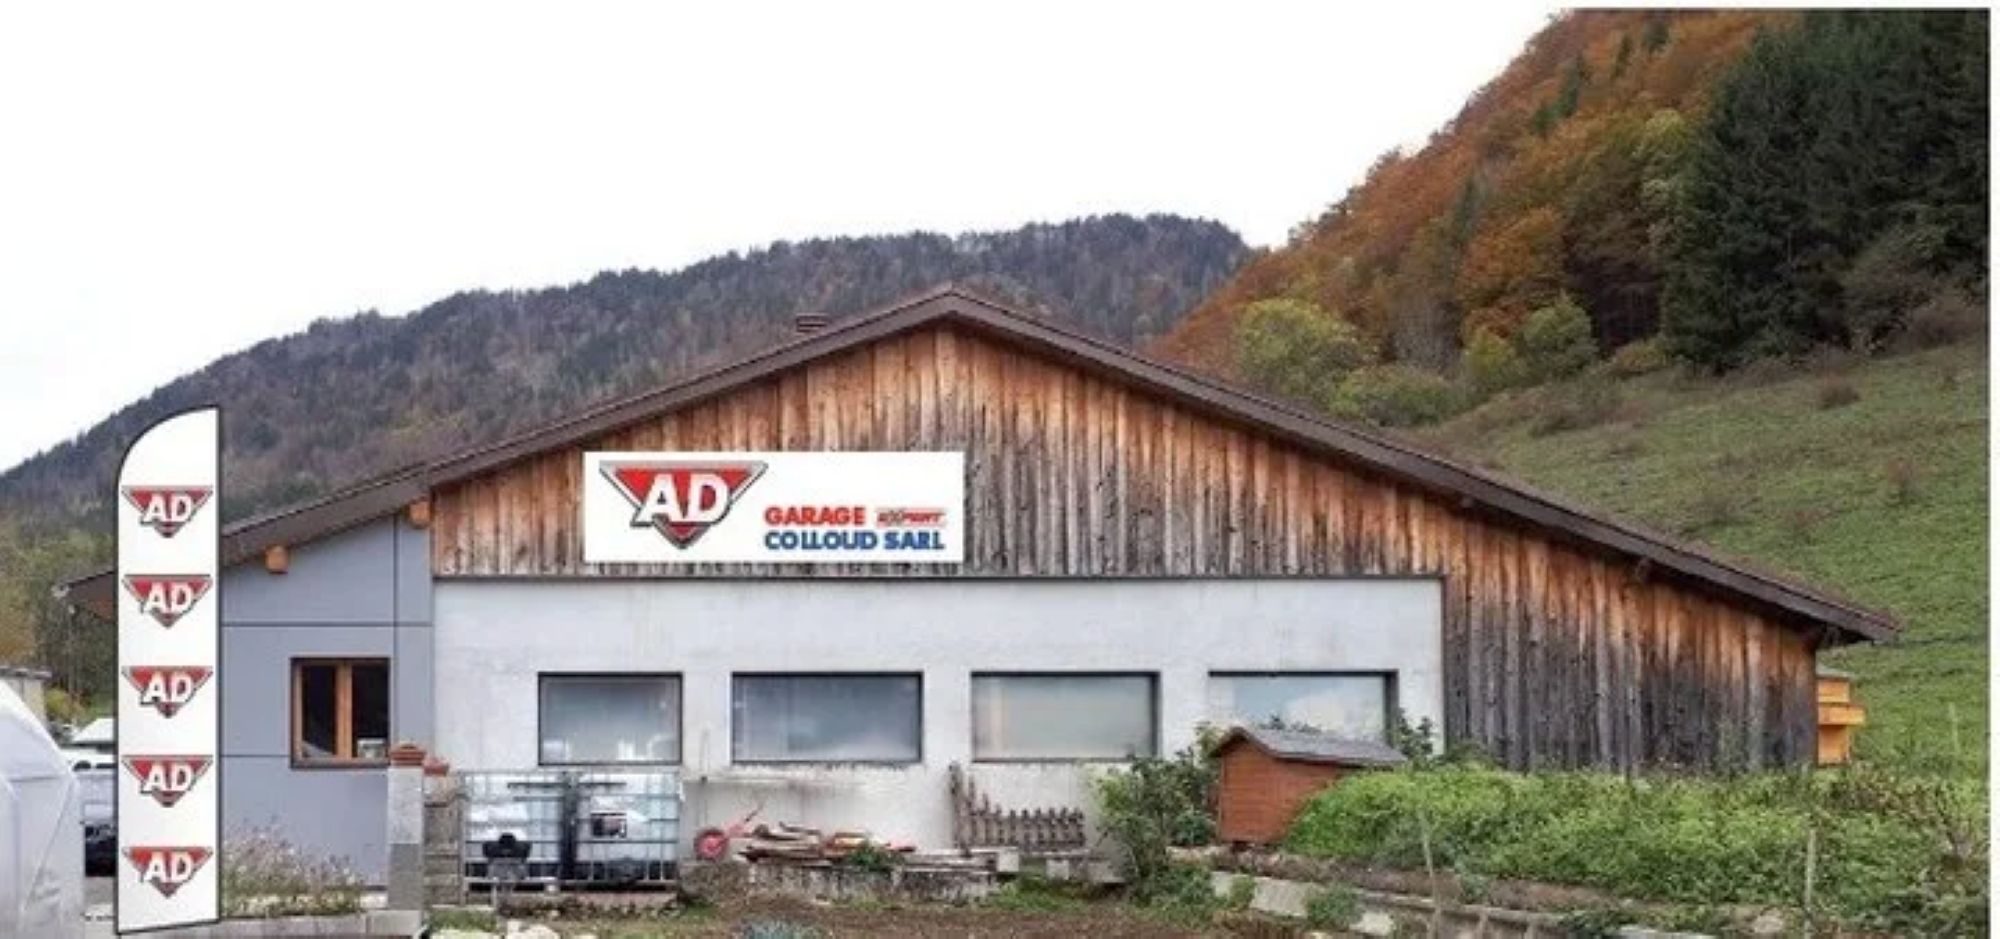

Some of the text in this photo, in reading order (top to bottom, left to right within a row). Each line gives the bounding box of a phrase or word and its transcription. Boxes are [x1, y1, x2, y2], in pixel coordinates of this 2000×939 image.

[141, 493, 194, 523] AD
[632, 473, 731, 524] AD
[764, 506, 866, 526] GARAGE
[764, 531, 945, 550] COLLOUD SARL
[141, 581, 194, 613] AD
[141, 671, 194, 703] AD
[141, 762, 194, 793] AD
[140, 850, 193, 883] AD
